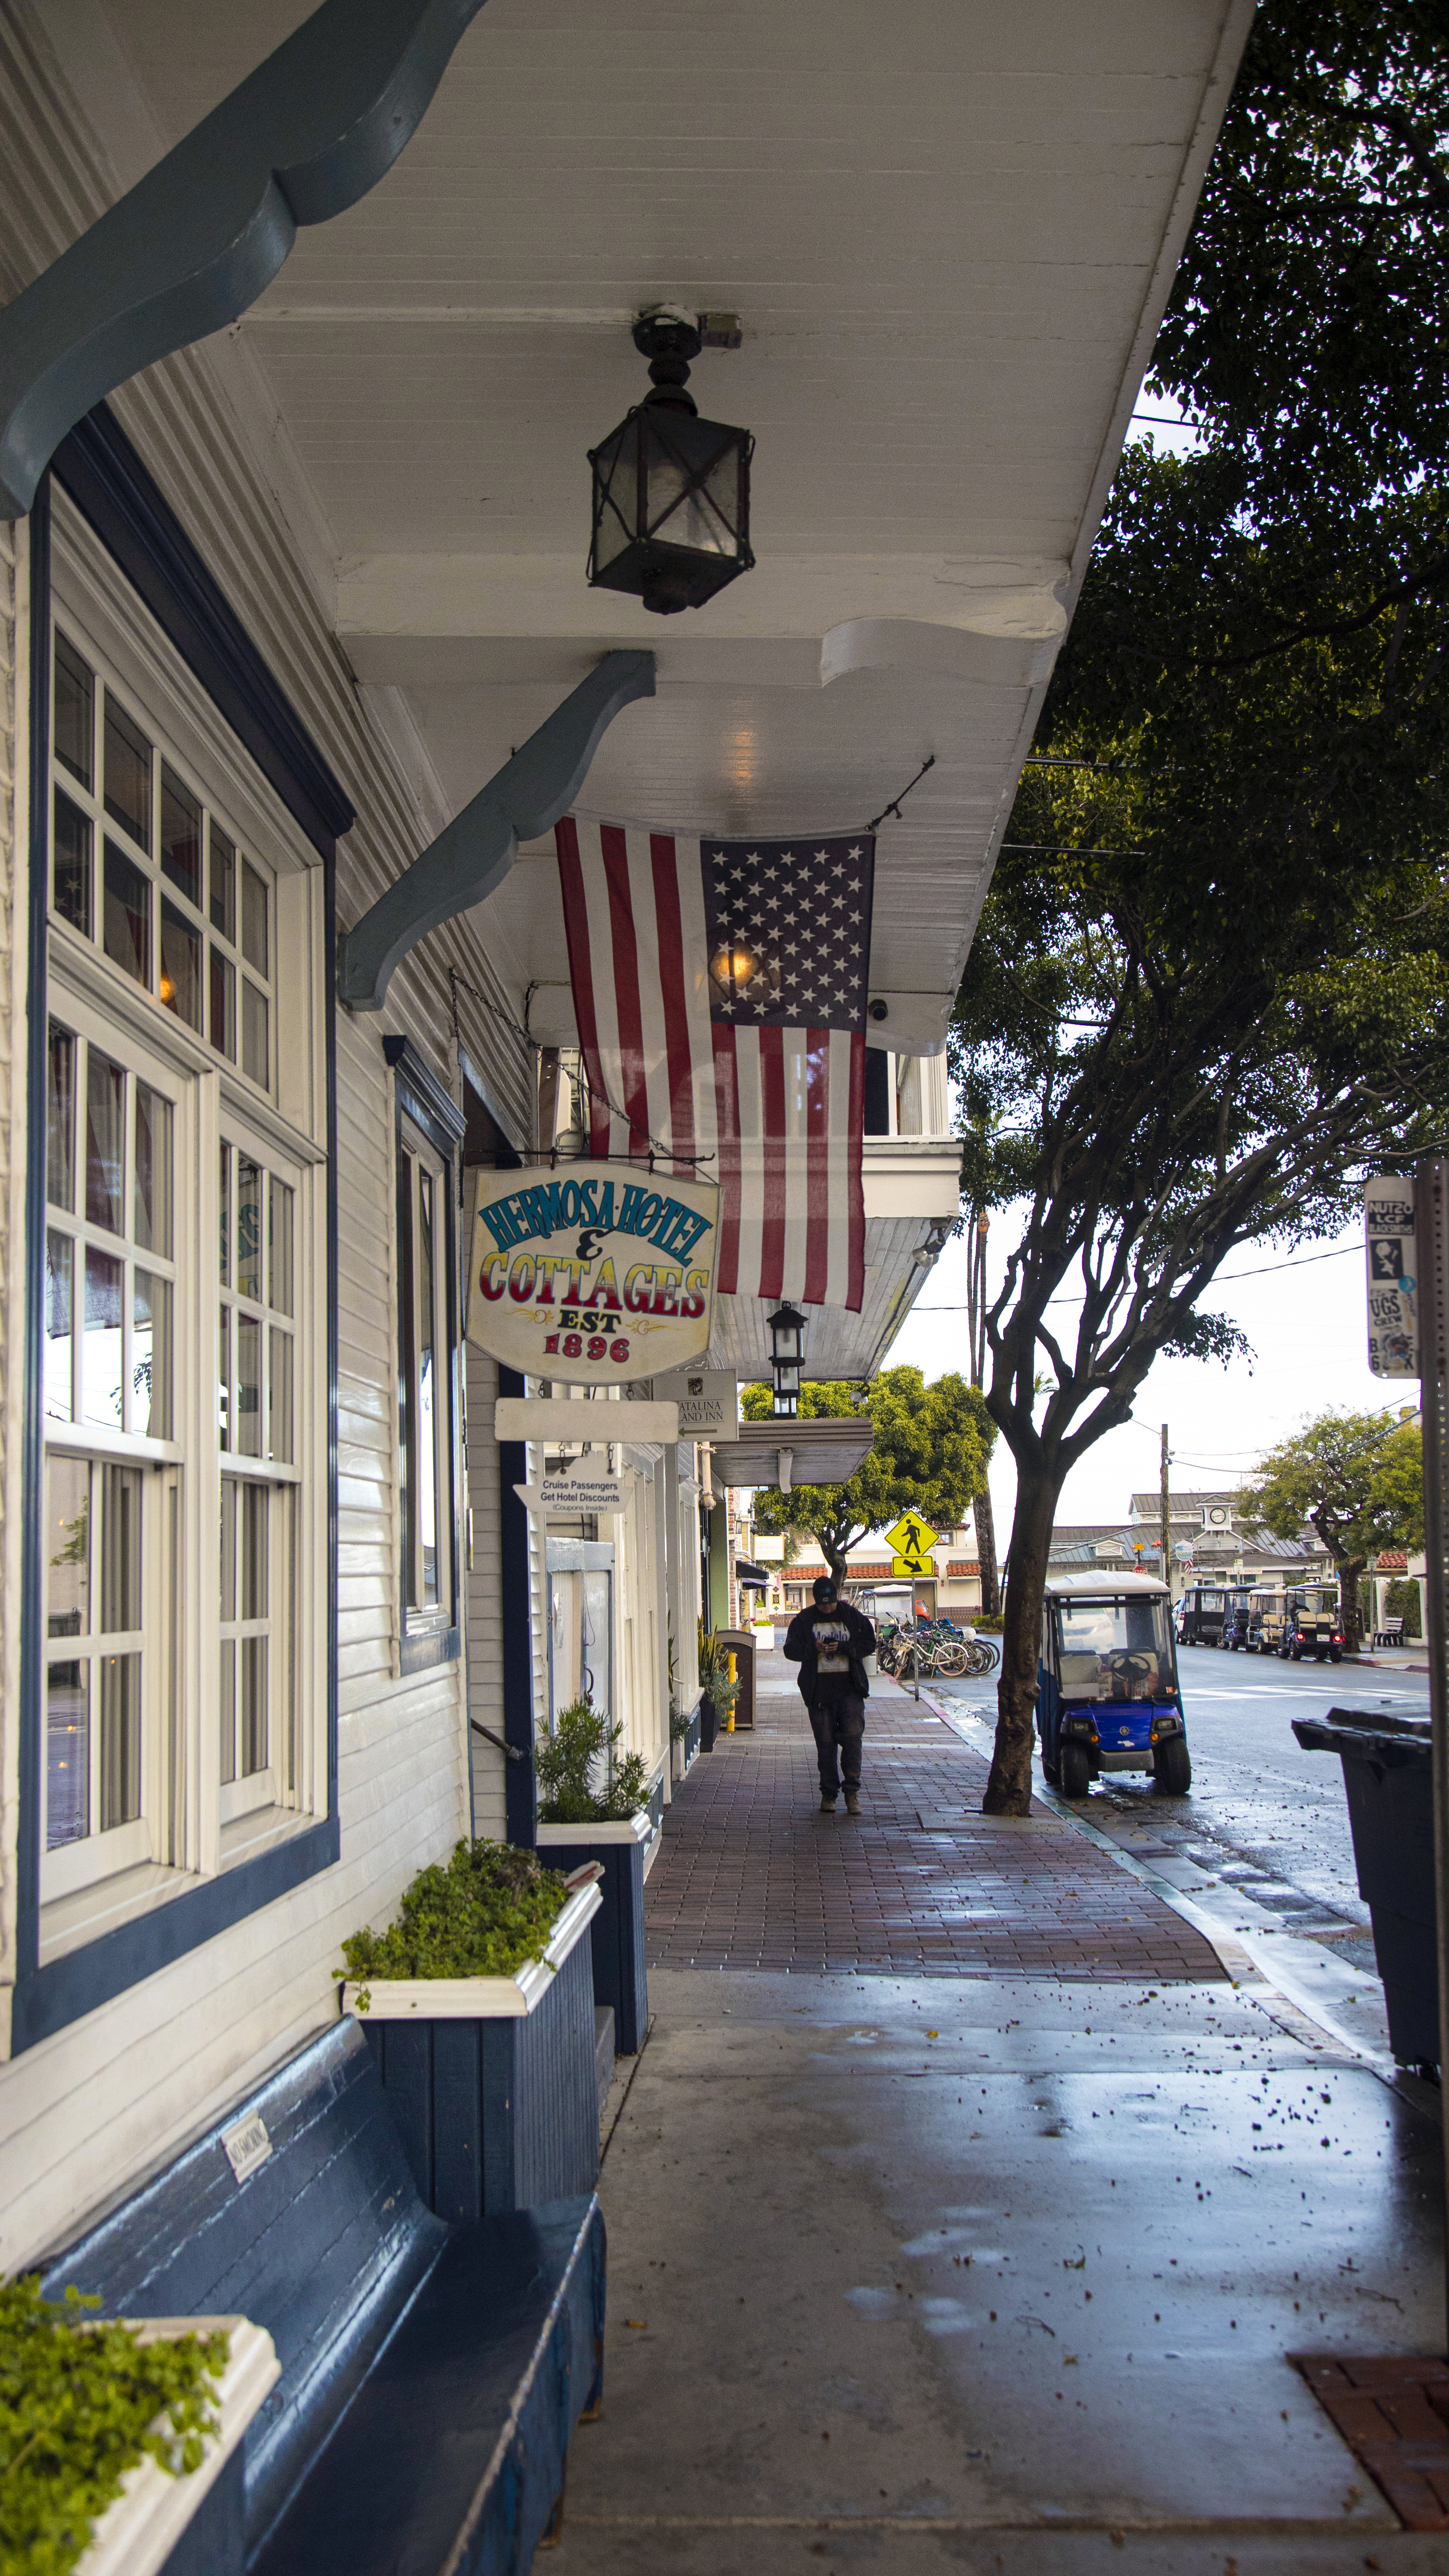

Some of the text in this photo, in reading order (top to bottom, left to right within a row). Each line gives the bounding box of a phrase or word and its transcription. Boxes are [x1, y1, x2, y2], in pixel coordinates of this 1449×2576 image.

[478, 1180, 713, 1268] HERMOSA HOTEL
[576, 1228, 618, 1261] &
[479, 1251, 709, 1319] COTTAGES
[1370, 1295, 1400, 1317] UGS
[557, 1309, 621, 1333] EST
[543, 1333, 629, 1362] 1896
[679, 1401, 721, 1411] ATALINA
[706, 1412, 723, 1421] INN
[541, 1492, 620, 1502] Get Hotel Discounts
[543, 1480, 618, 1492] Cruise Passengers
[553, 1504, 584, 1512] (Coupons
